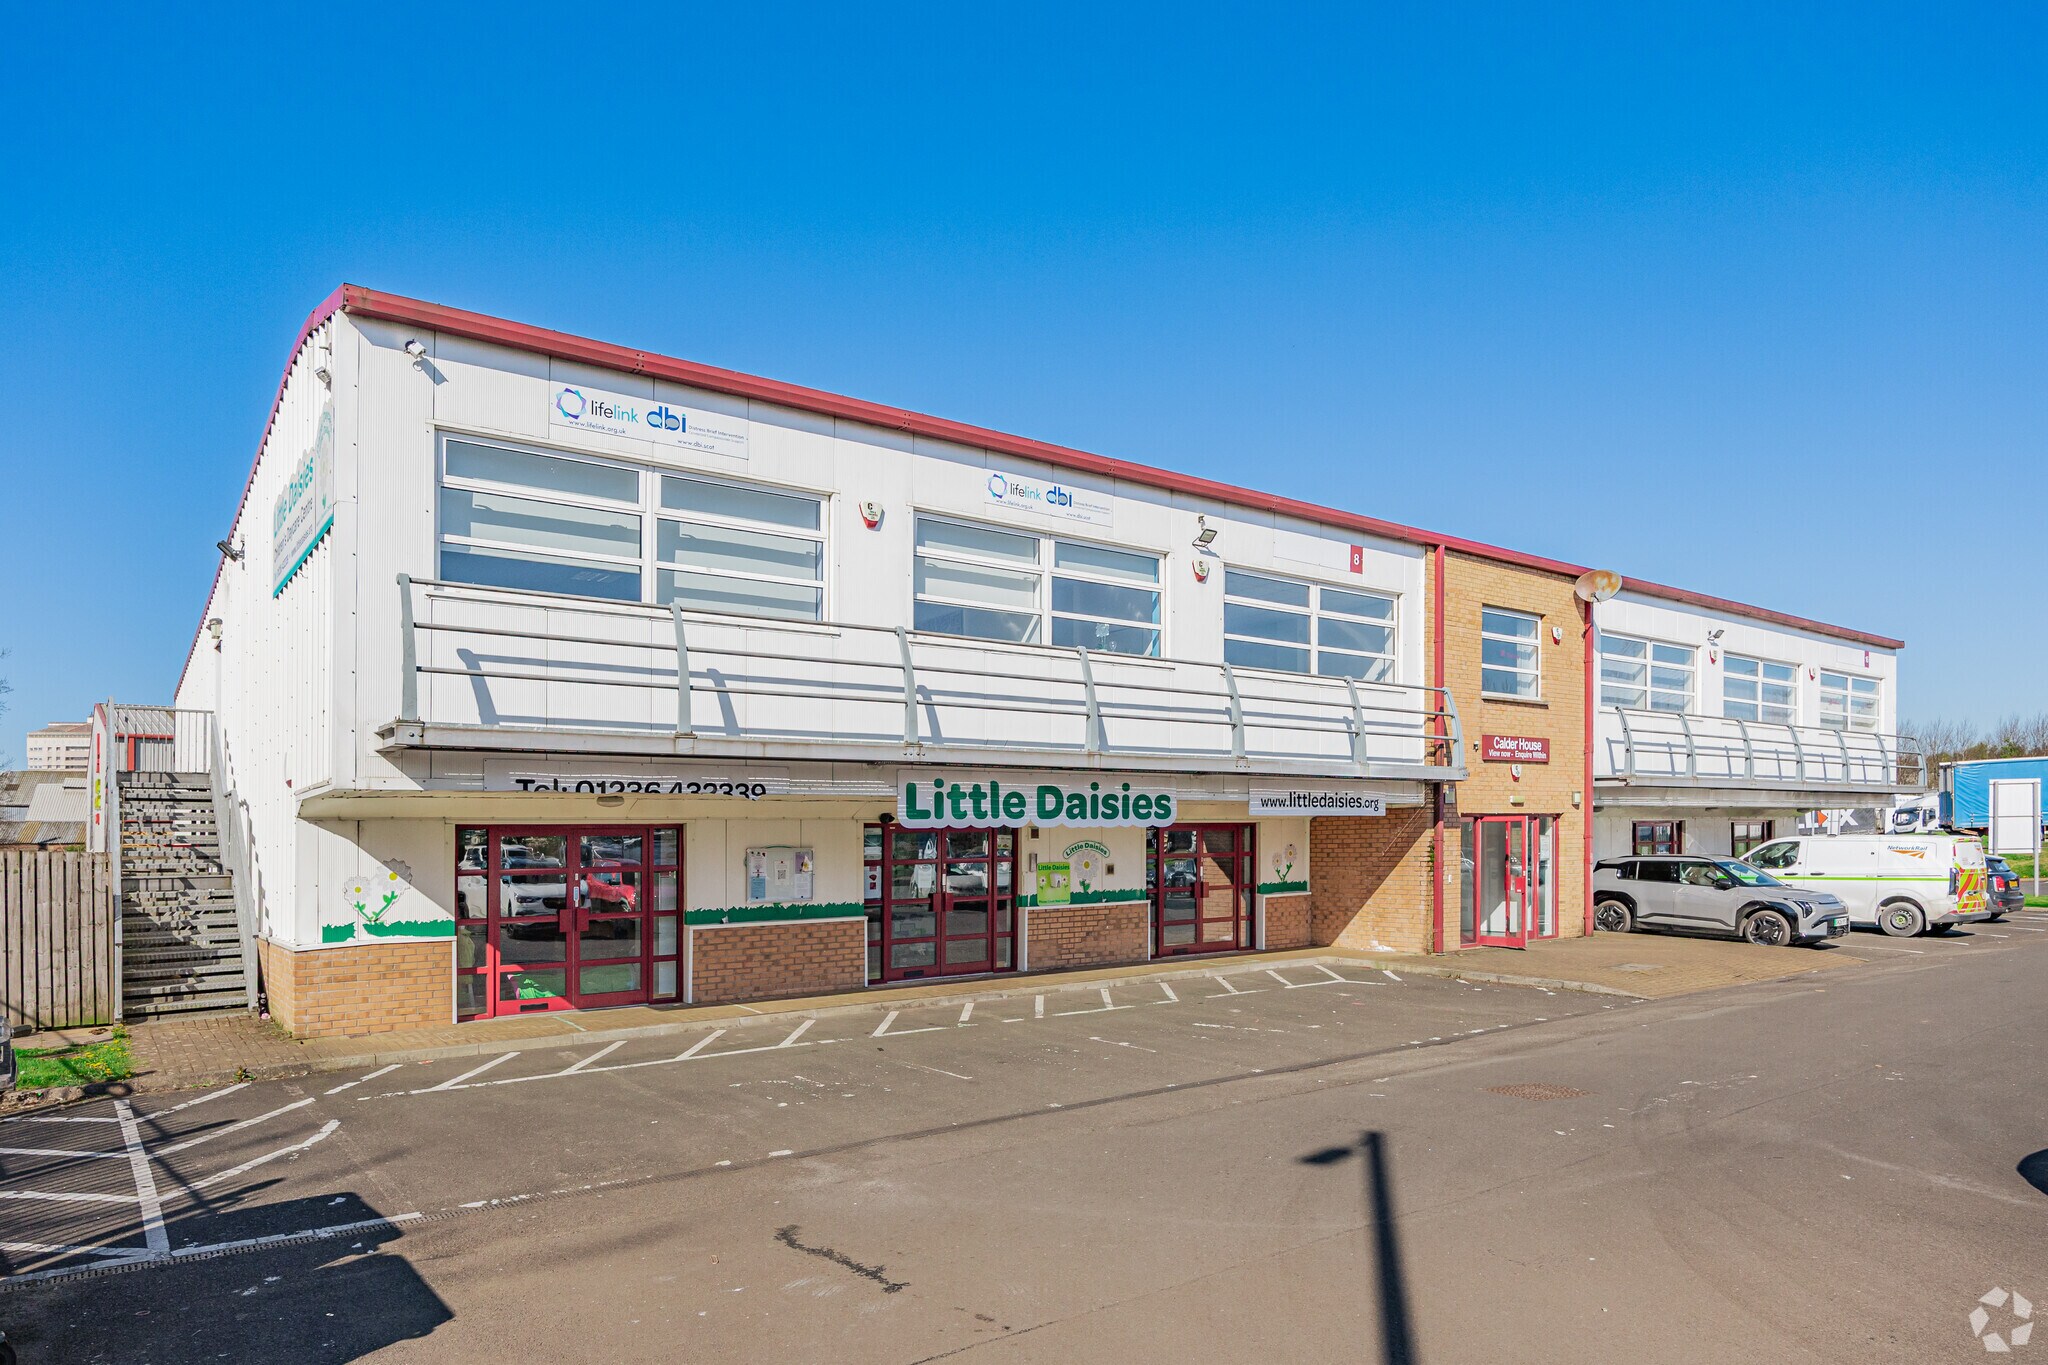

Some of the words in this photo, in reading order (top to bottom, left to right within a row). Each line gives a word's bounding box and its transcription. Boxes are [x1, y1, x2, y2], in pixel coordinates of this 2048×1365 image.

[591, 399, 639, 424] lifelink
[646, 405, 687, 433] dbi
[568, 420, 626, 434] www.lifelink.org.uk
[1010, 482, 1042, 501] lifelink
[1045, 486, 1073, 508] dbi
[1353, 553, 1360, 566] 8
[1493, 736, 1518, 750] Calder
[1518, 738, 1542, 751] House
[1488, 749, 1500, 757] View
[1514, 750, 1533, 759] Enquire
[905, 778, 1027, 820] Little
[1036, 781, 1172, 820] Daisies
[1260, 791, 1380, 812] www.littledaisies.org
[1065, 844, 1084, 857] Little
[1084, 842, 1108, 855] Daisies
